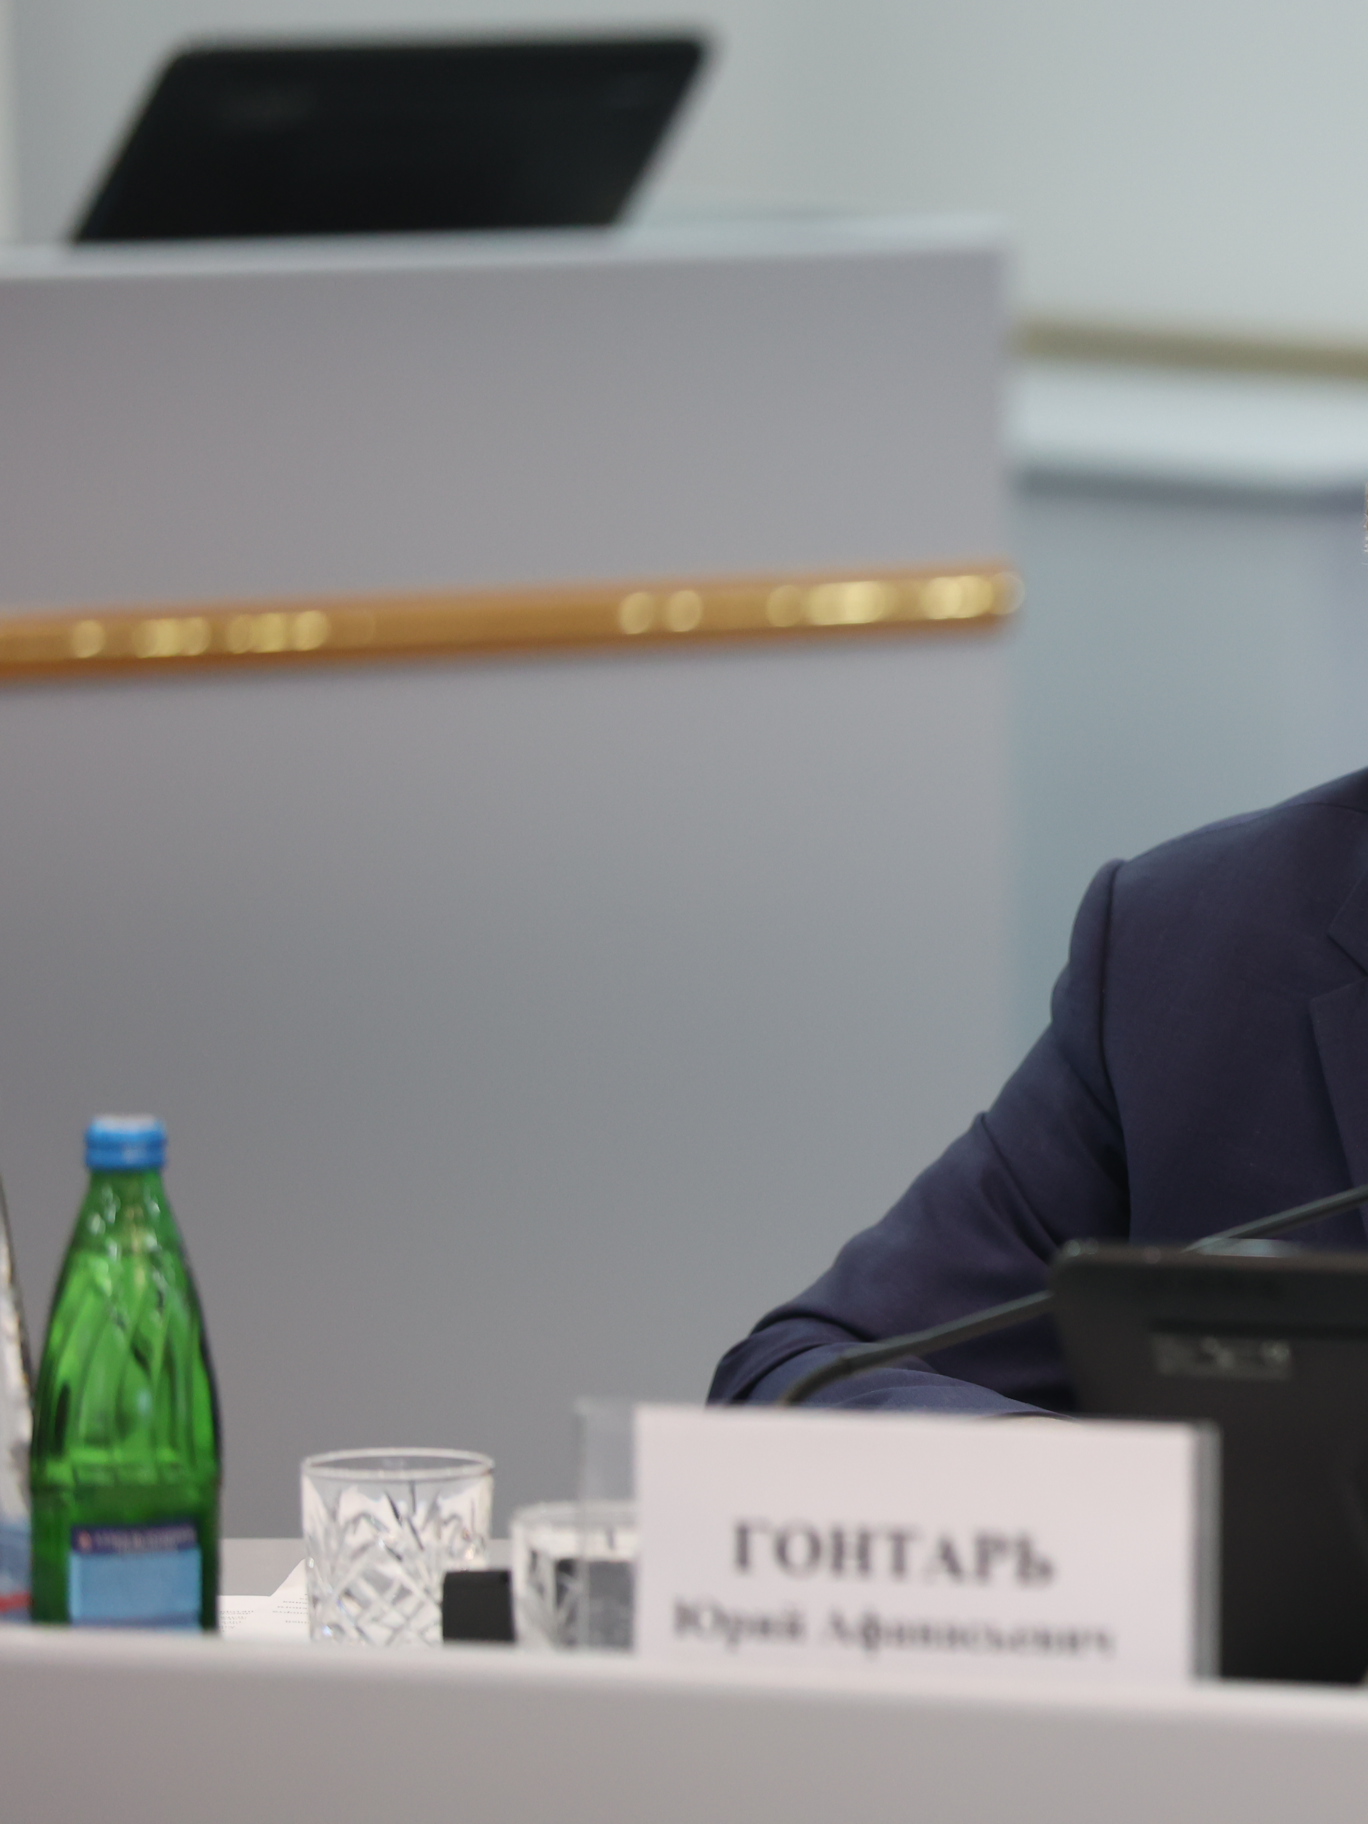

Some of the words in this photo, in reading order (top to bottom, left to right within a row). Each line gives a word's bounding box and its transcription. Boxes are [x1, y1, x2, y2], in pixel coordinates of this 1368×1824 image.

[732, 1518, 1055, 1588] ГОНТАРЬ
[673, 1599, 804, 1652] Юрий
[824, 1610, 1115, 1658] Афанасьевич
